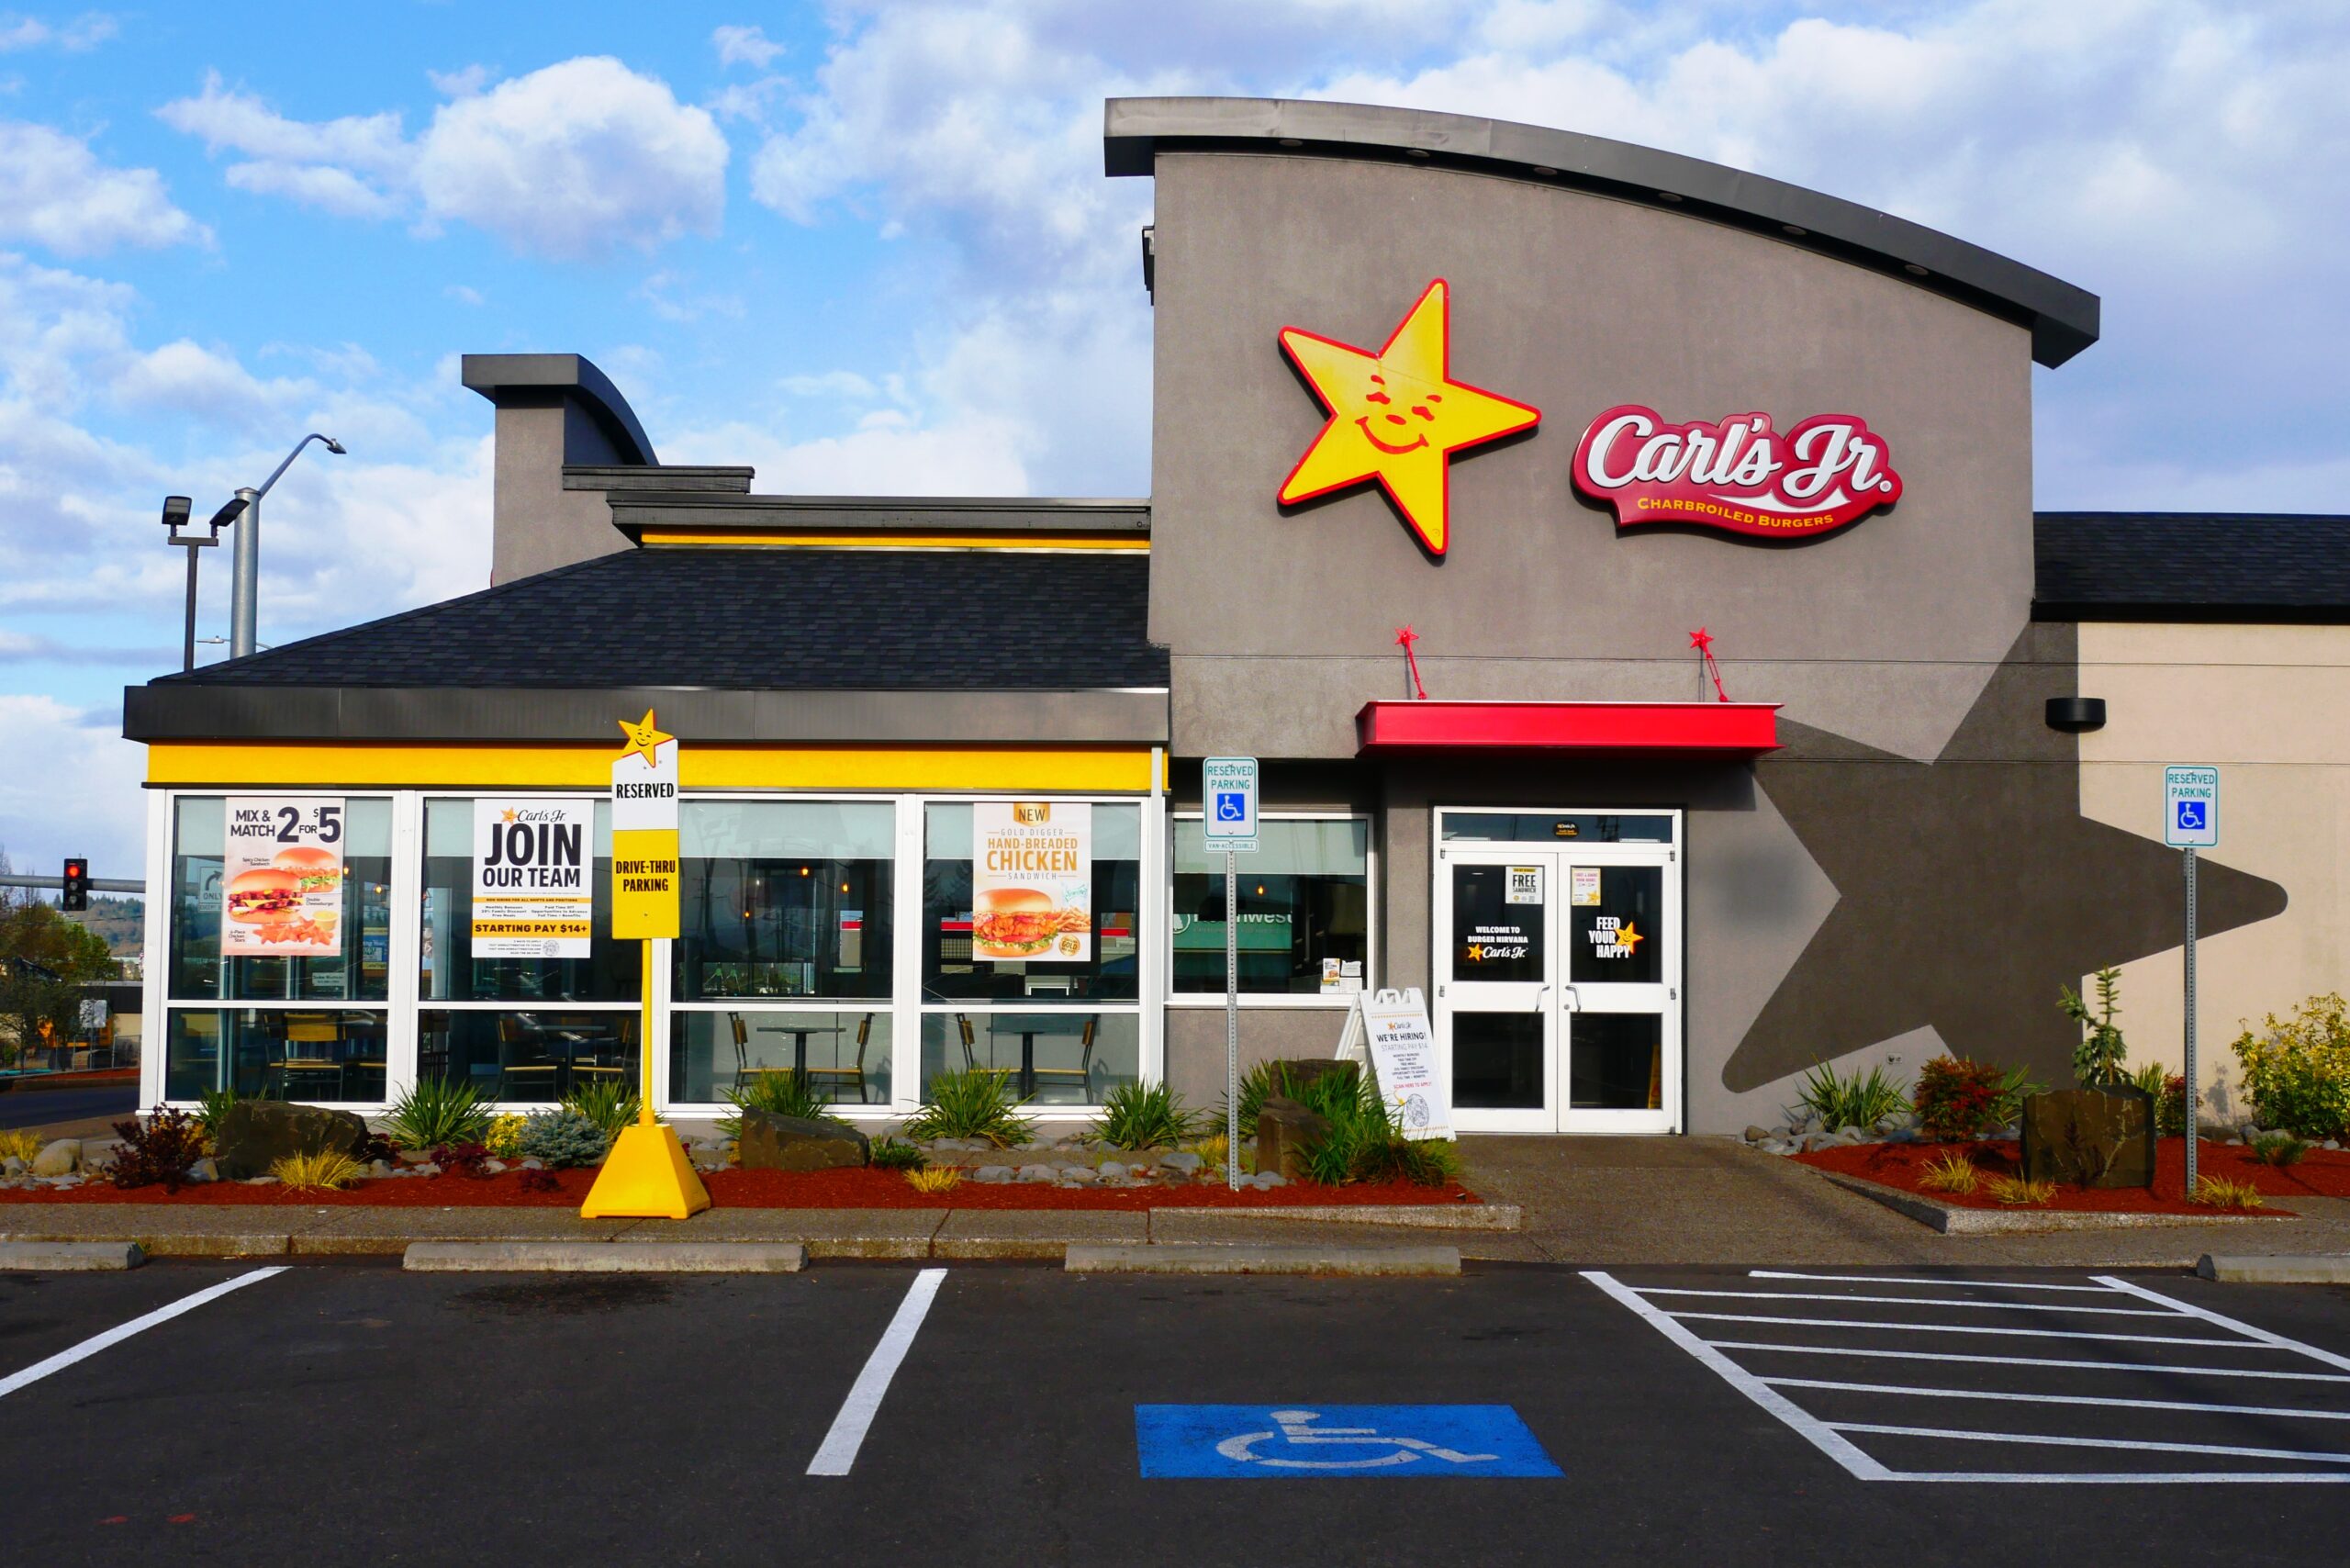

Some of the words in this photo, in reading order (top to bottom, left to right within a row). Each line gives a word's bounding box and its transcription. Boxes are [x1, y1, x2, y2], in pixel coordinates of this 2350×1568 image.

[1587, 415, 1782, 488] Carl's
[1783, 424, 1892, 498] Jr.
[1637, 498, 1754, 523] CHARBROILED
[1758, 514, 1834, 528] BURGERS
[1207, 766, 1254, 776] RESERVED
[1211, 779, 1250, 790] PARKING
[2168, 773, 2215, 784] RESERVED
[616, 783, 675, 799] RESERVED
[2172, 788, 2211, 798] PARKING
[236, 810, 259, 822] MIX
[262, 810, 271, 822] &
[517, 809, 549, 822] Carl's
[1018, 809, 1046, 822] NEW
[230, 824, 275, 836] MATCH
[277, 806, 300, 843] 2
[299, 825, 318, 834] FOR
[313, 807, 341, 843] $5
[1001, 828, 1024, 836] GOLD
[1030, 828, 1064, 836] DIGGER
[485, 823, 582, 866] JOIN
[988, 838, 1078, 849] HAND-BREADED
[987, 850, 1078, 871] CHICKEN
[616, 860, 676, 874] DRIVE-THRU
[483, 868, 522, 887] OUR
[528, 868, 580, 887] TEAM
[1008, 872, 1057, 880] SANDWICH
[1513, 875, 1536, 887] FREE
[623, 879, 668, 891] PARKING
[475, 924, 532, 933] STARTING
[534, 924, 556, 933] PAY
[560, 924, 588, 934] $14+
[1596, 916, 1620, 930] FEED
[1588, 930, 1616, 944] YOUR
[1482, 946, 1511, 958] Carl's
[1596, 945, 1629, 958] HAPPY
[1376, 1033, 1398, 1042] WE'RE
